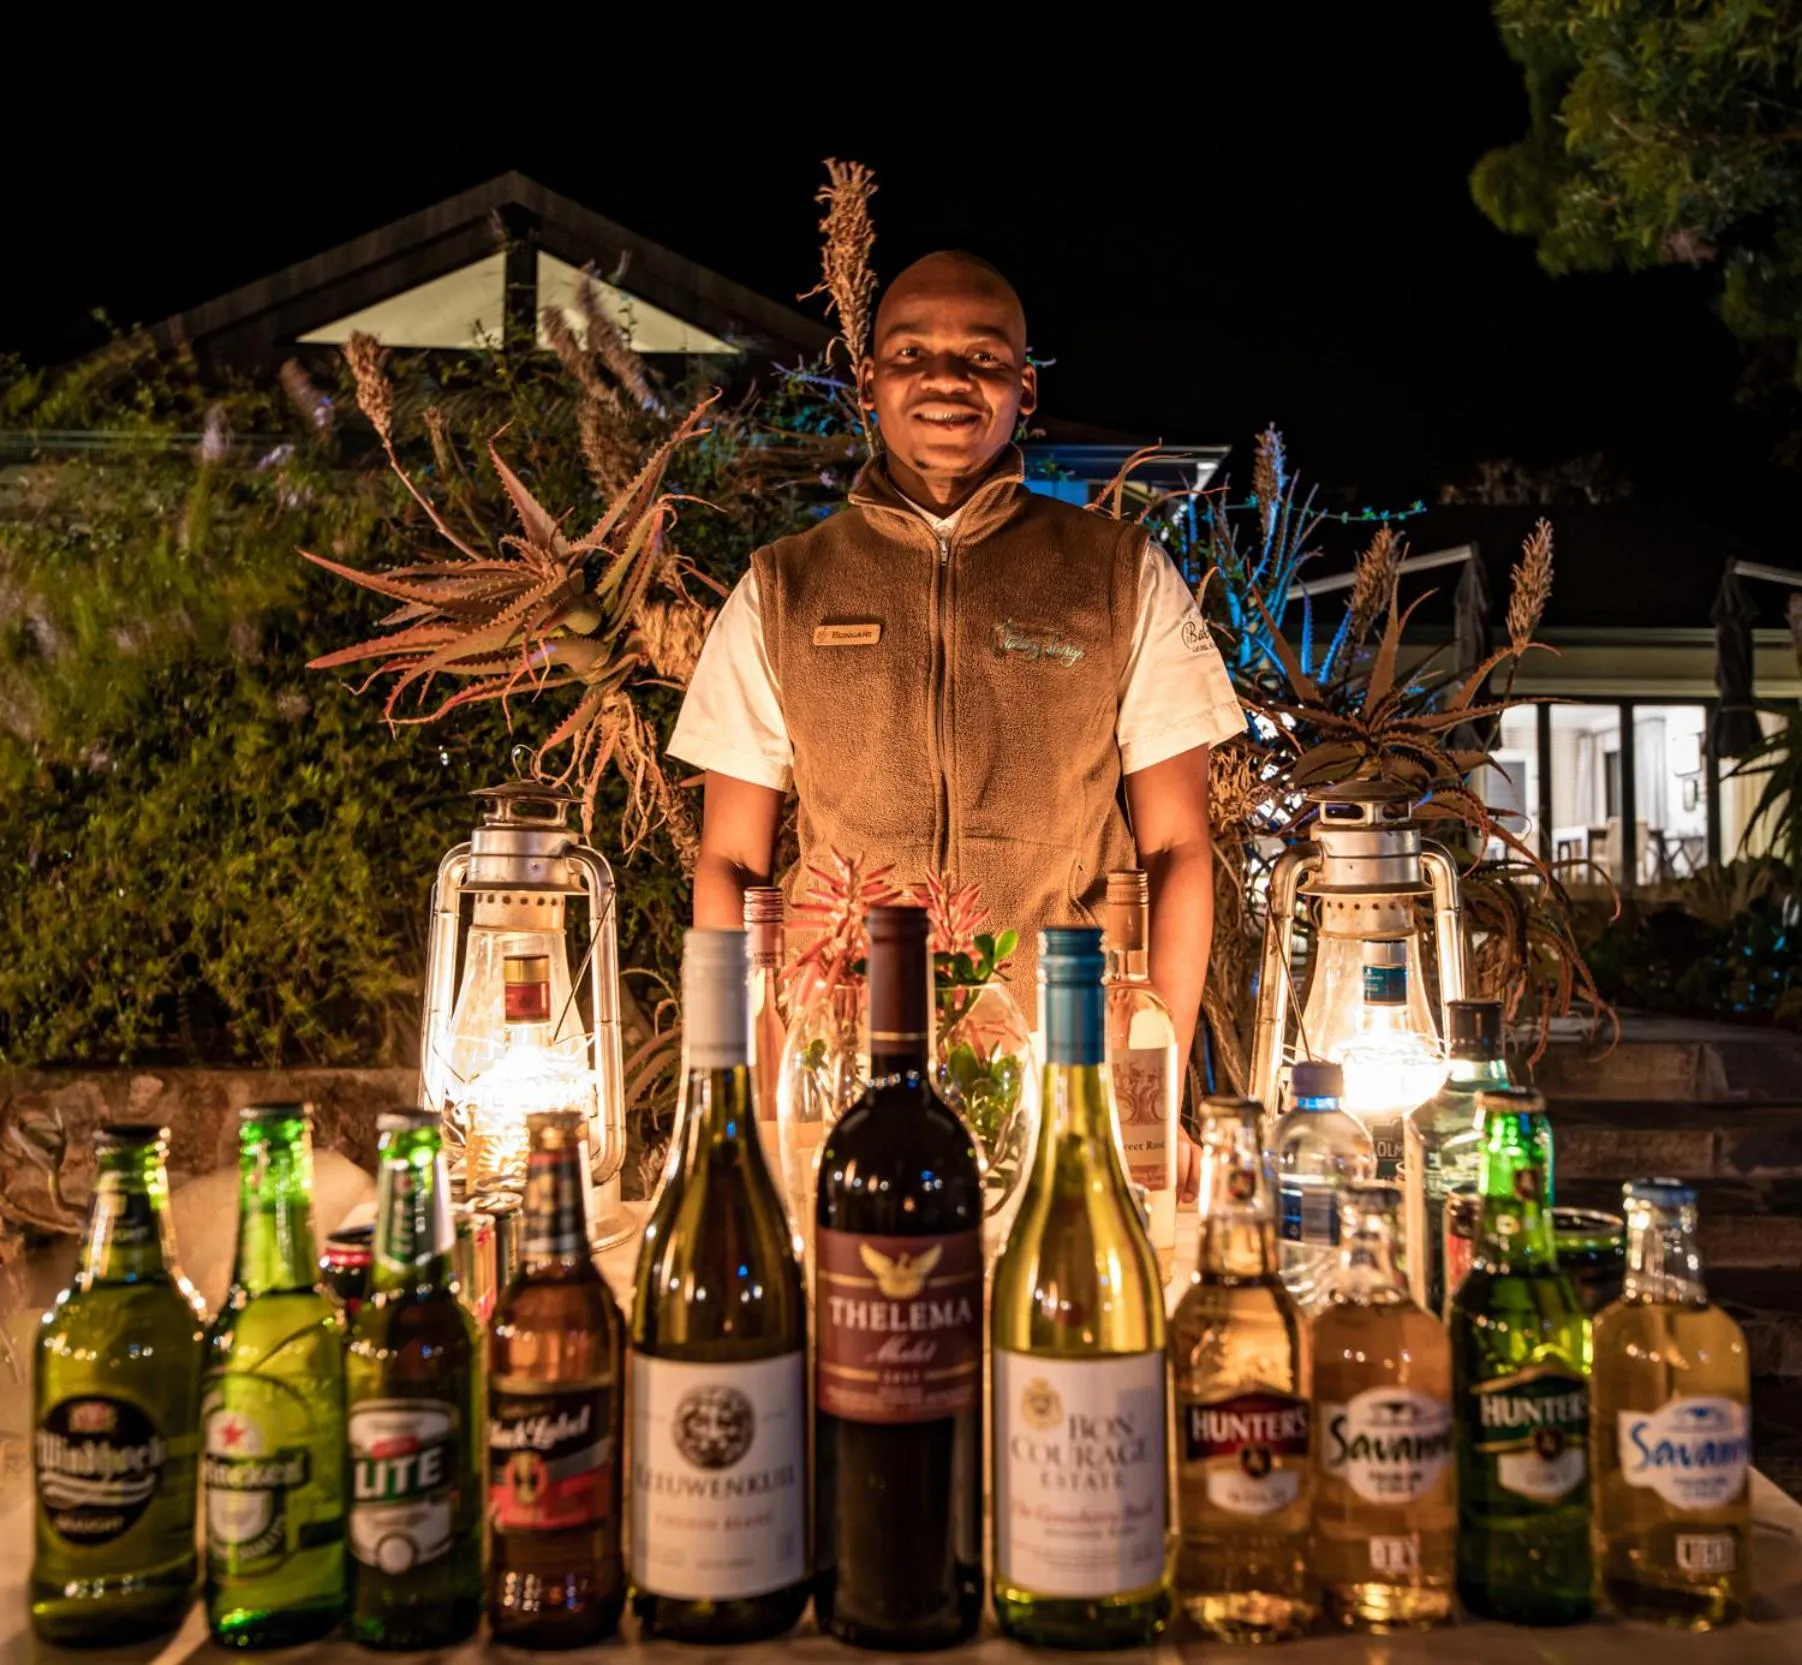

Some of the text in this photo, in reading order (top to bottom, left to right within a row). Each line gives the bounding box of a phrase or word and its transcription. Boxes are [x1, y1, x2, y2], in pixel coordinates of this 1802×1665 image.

[828, 1297, 972, 1332] THELEMA
[1068, 1411, 1135, 1440] BON
[1010, 1434, 1150, 1471] COURAGE
[354, 1447, 444, 1499] LITE
